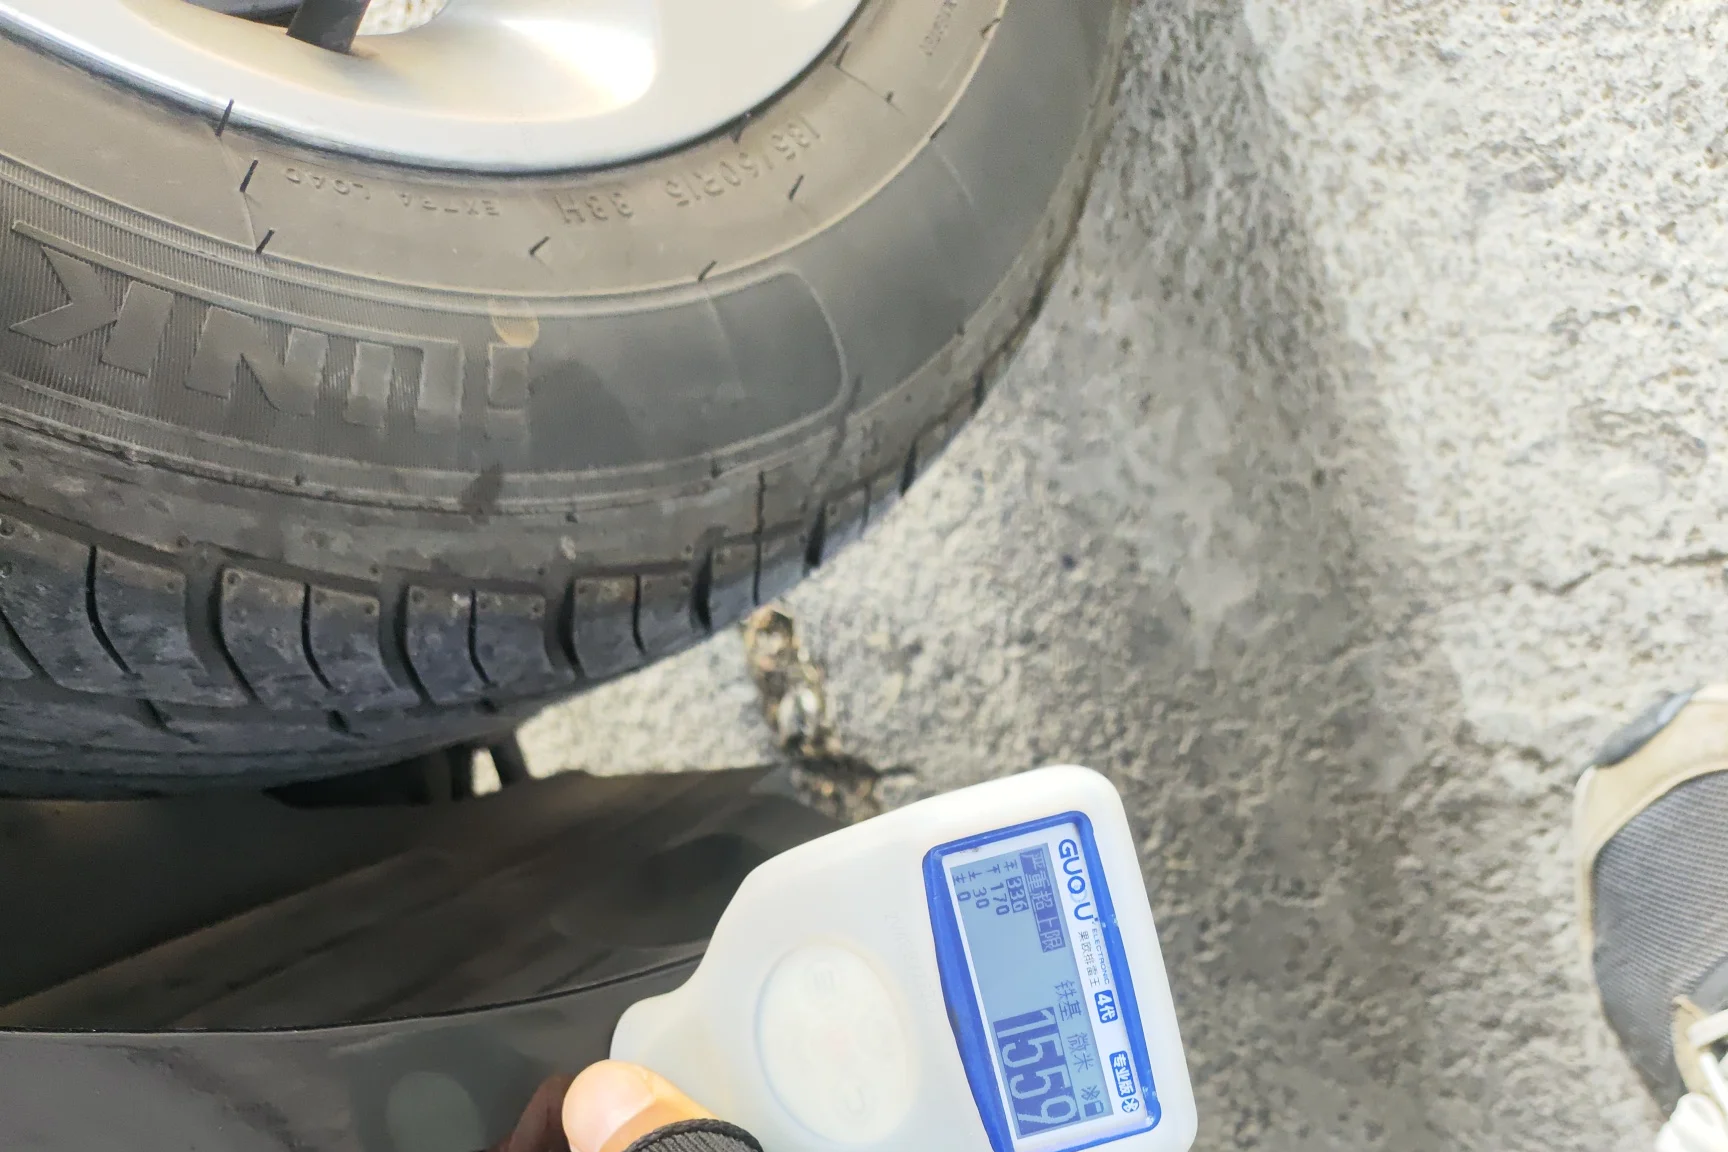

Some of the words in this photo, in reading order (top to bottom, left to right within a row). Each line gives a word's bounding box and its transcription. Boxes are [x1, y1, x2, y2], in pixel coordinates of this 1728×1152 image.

[957, 892, 971, 902] 0
[973, 888, 990, 909] 30
[990, 882, 1010, 915] 170
[1006, 877, 1028, 911] 336
[1021, 853, 1065, 952] 严重超上限
[1091, 927, 1111, 985] ELECTRONIC
[1054, 979, 1083, 1022] 铁基
[1095, 992, 1117, 1022] 4代
[996, 1009, 1078, 1126] 1559
[1066, 1031, 1094, 1073] 微米
[1111, 1053, 1135, 1096] 专业版
